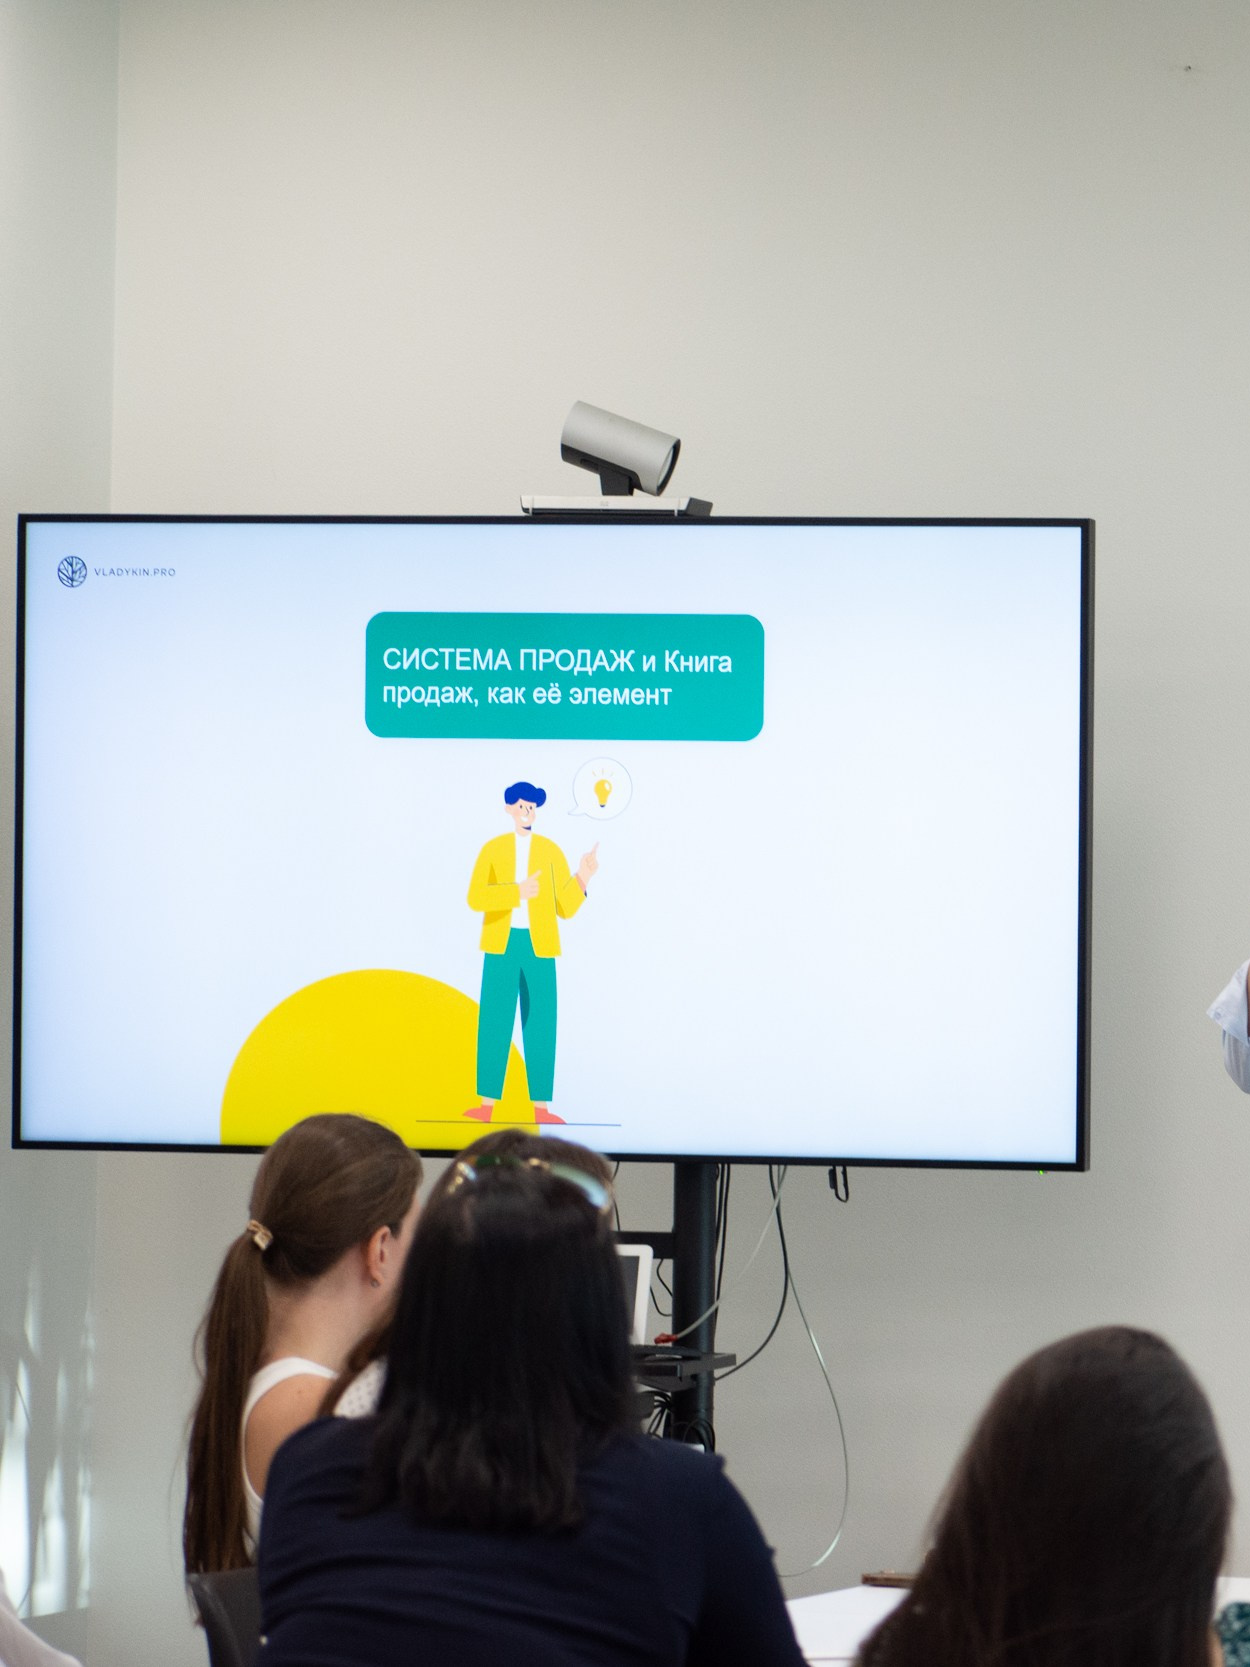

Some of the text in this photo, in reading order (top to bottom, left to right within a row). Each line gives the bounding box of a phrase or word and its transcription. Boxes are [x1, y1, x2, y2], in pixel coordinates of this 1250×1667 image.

[94, 567, 176, 577] VLADYKIN.PRO
[383, 647, 732, 676] СИСТЕМА ПРОДАЖ и Книга
[383, 682, 673, 708] продаж, как её элемент
